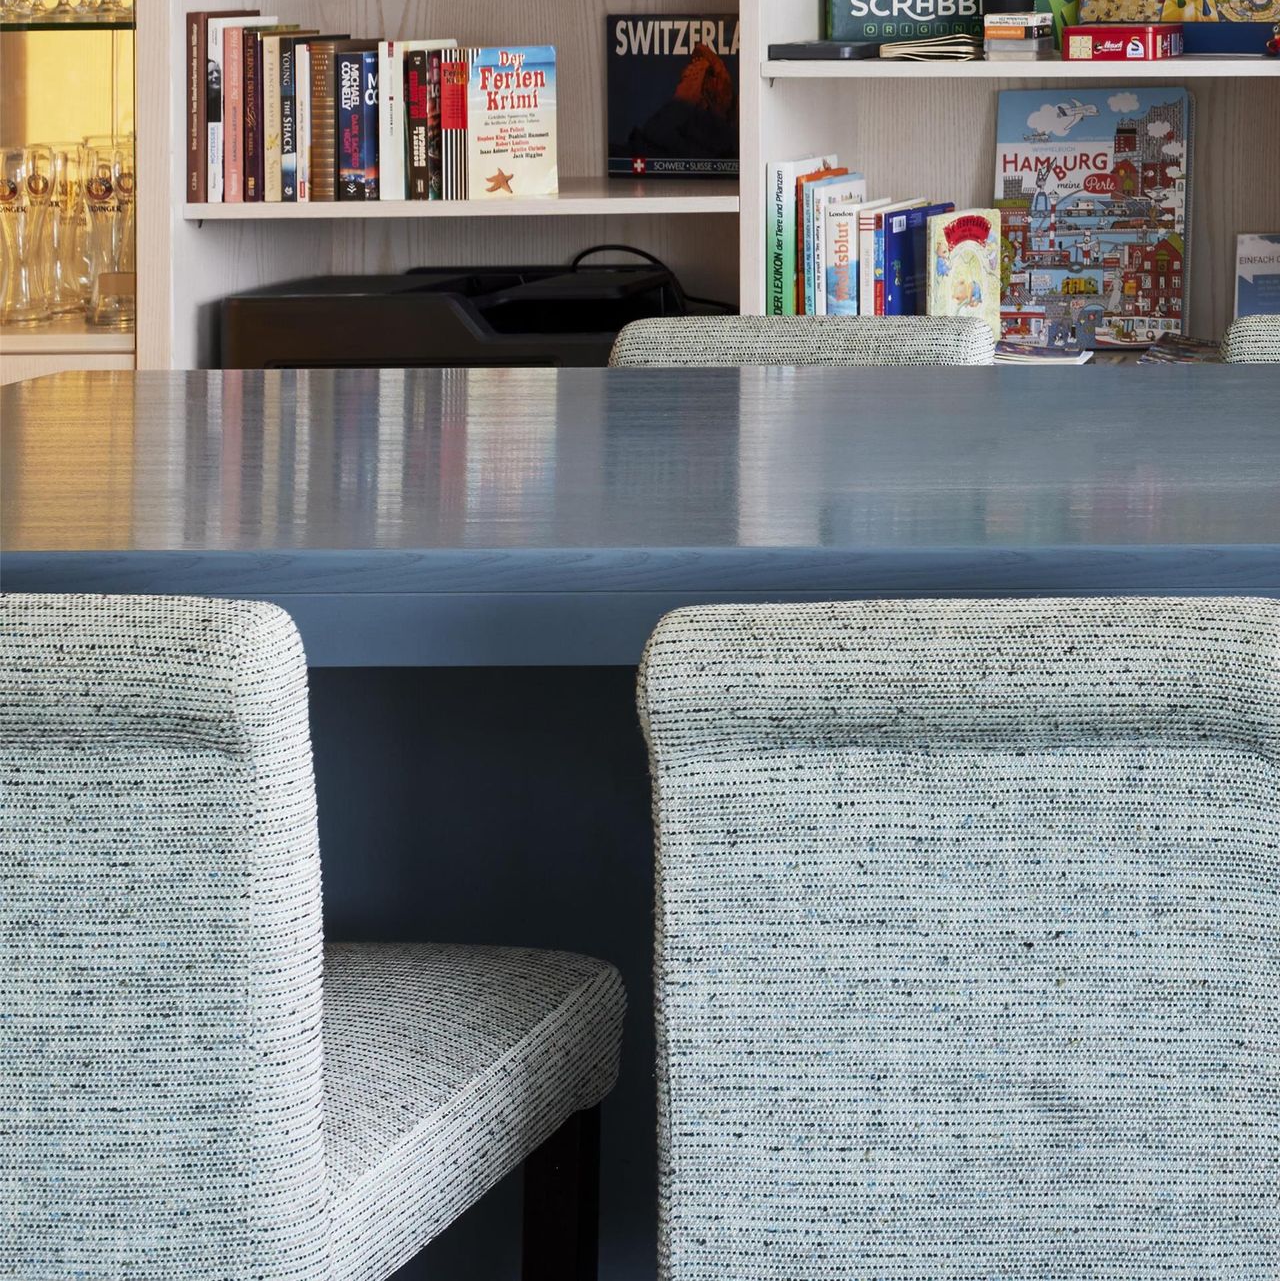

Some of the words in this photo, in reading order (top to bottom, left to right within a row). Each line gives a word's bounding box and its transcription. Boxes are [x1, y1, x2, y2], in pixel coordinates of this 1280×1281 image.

[500, 51, 524, 66] Der
[341, 62, 351, 110] CONNELLY
[350, 64, 359, 107] MICHAEL
[480, 67, 546, 91] Ferien
[486, 90, 538, 111] Krimi
[283, 117, 293, 152] SHACK
[1057, 181, 1081, 190] meine
[1085, 177, 1116, 191] Perle
[834, 222, 849, 302] Wolfsblut
[1239, 256, 1274, 265] EINFACH
[773, 252, 783, 295] LEXIKON
